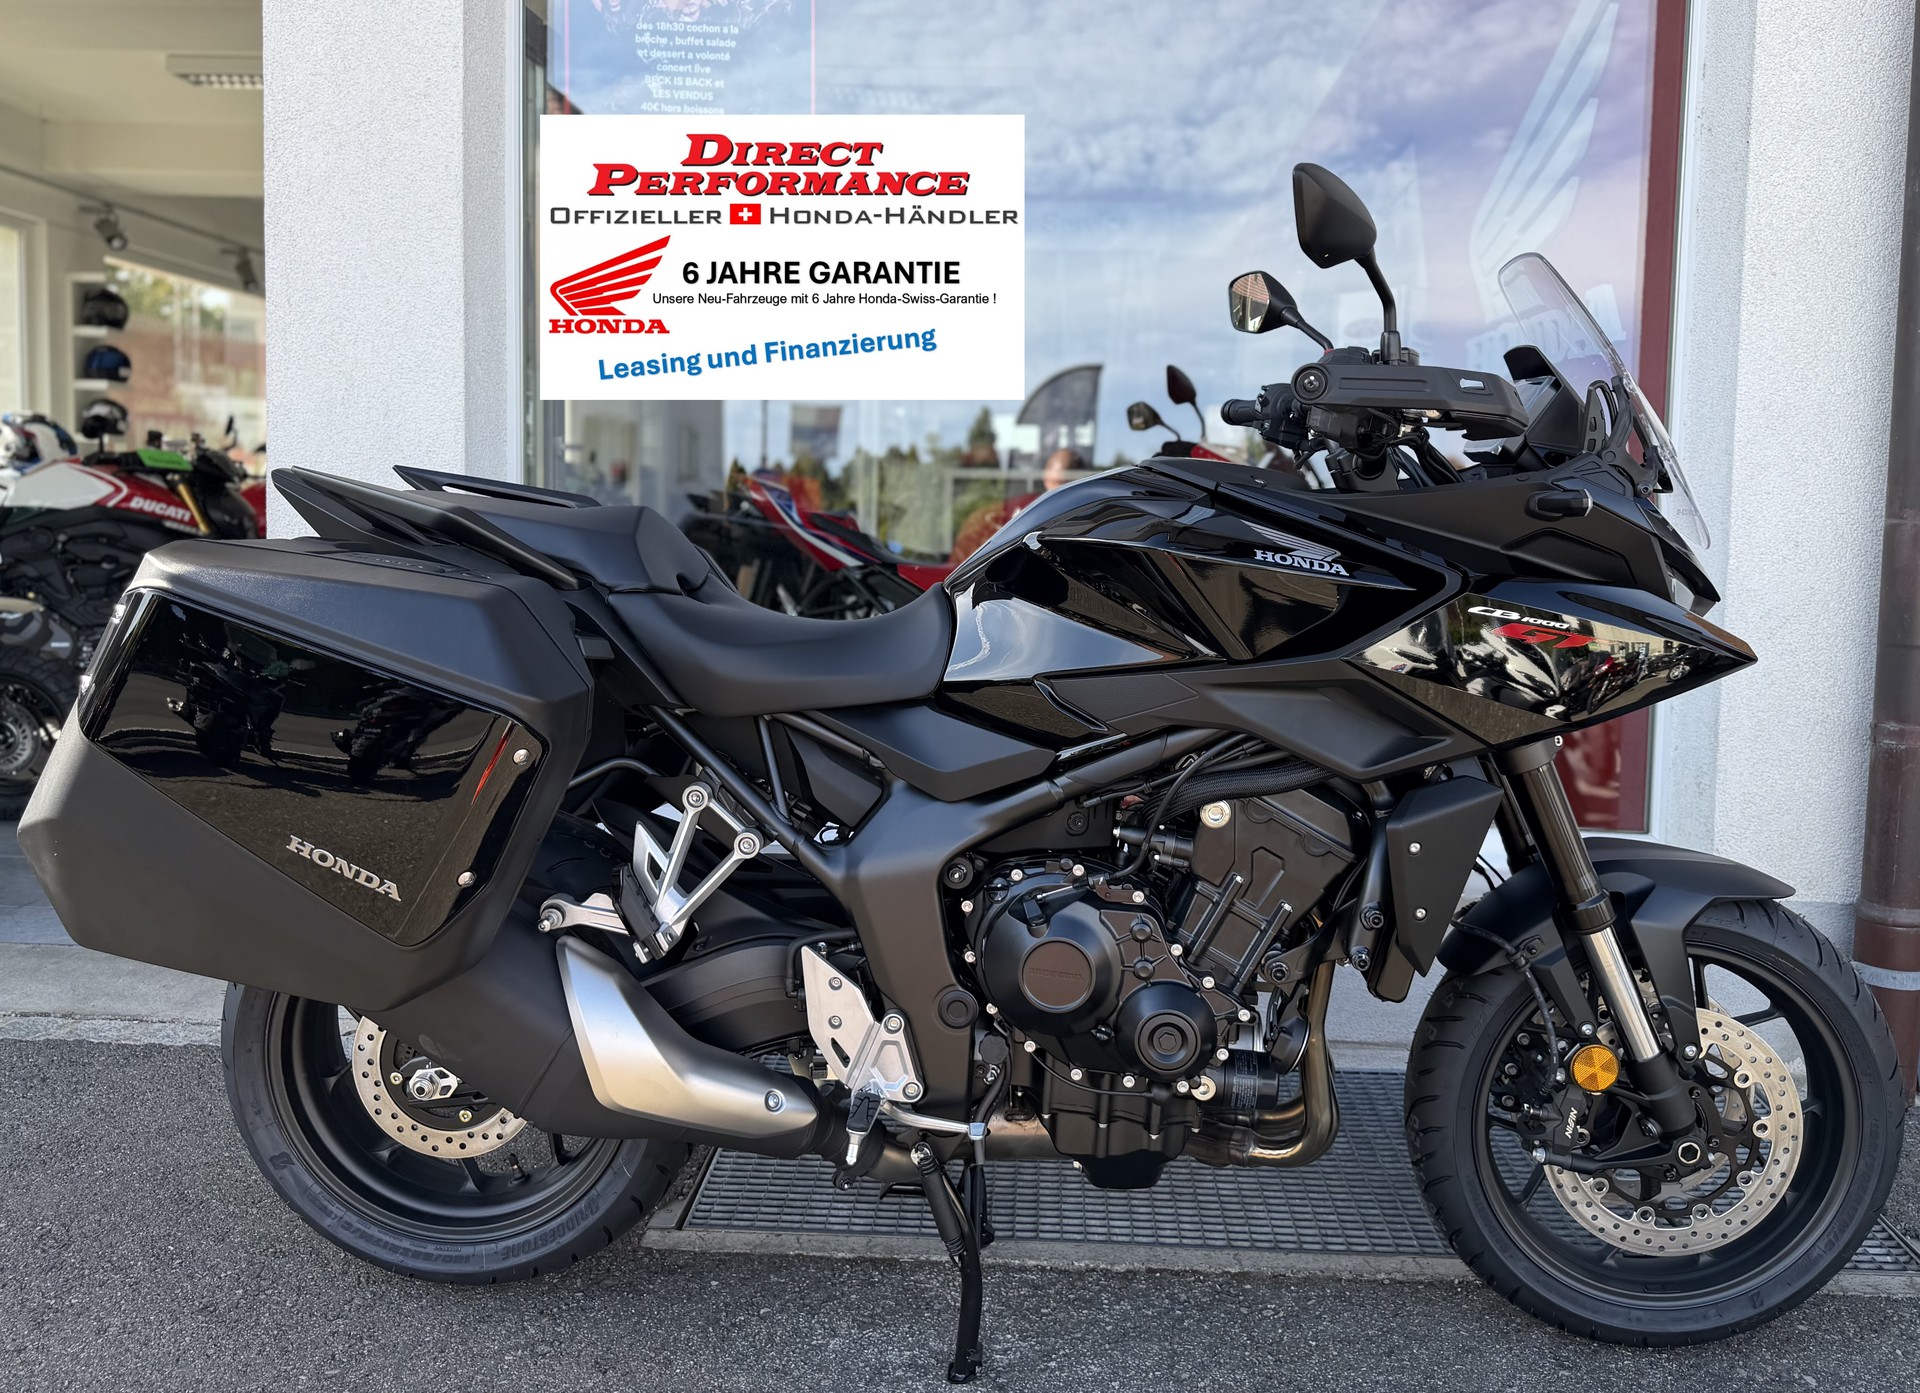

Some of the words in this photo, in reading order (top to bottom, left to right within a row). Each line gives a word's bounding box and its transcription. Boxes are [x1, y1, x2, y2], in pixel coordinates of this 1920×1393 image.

[656, 22, 684, 32] 18h30
[686, 23, 720, 34] cochon
[722, 26, 729, 34] a
[730, 25, 739, 34] la
[675, 35, 704, 46] buffet
[706, 37, 736, 48] salade
[649, 48, 685, 59] dessert
[696, 51, 730, 61] volonté
[656, 63, 692, 73] concert
[694, 63, 711, 74] live
[645, 75, 671, 85] BECK
[674, 76, 683, 86] IS
[685, 77, 713, 88] BACK
[714, 79, 725, 88] et
[653, 89, 671, 99] LES
[673, 90, 714, 101] VENDUS
[661, 103, 682, 113] hors
[129, 496, 192, 522] DUCATI
[1253, 549, 1350, 576] HONDA
[286, 834, 402, 902] HONDA
[1564, 1106, 1578, 1139] NISSIN
